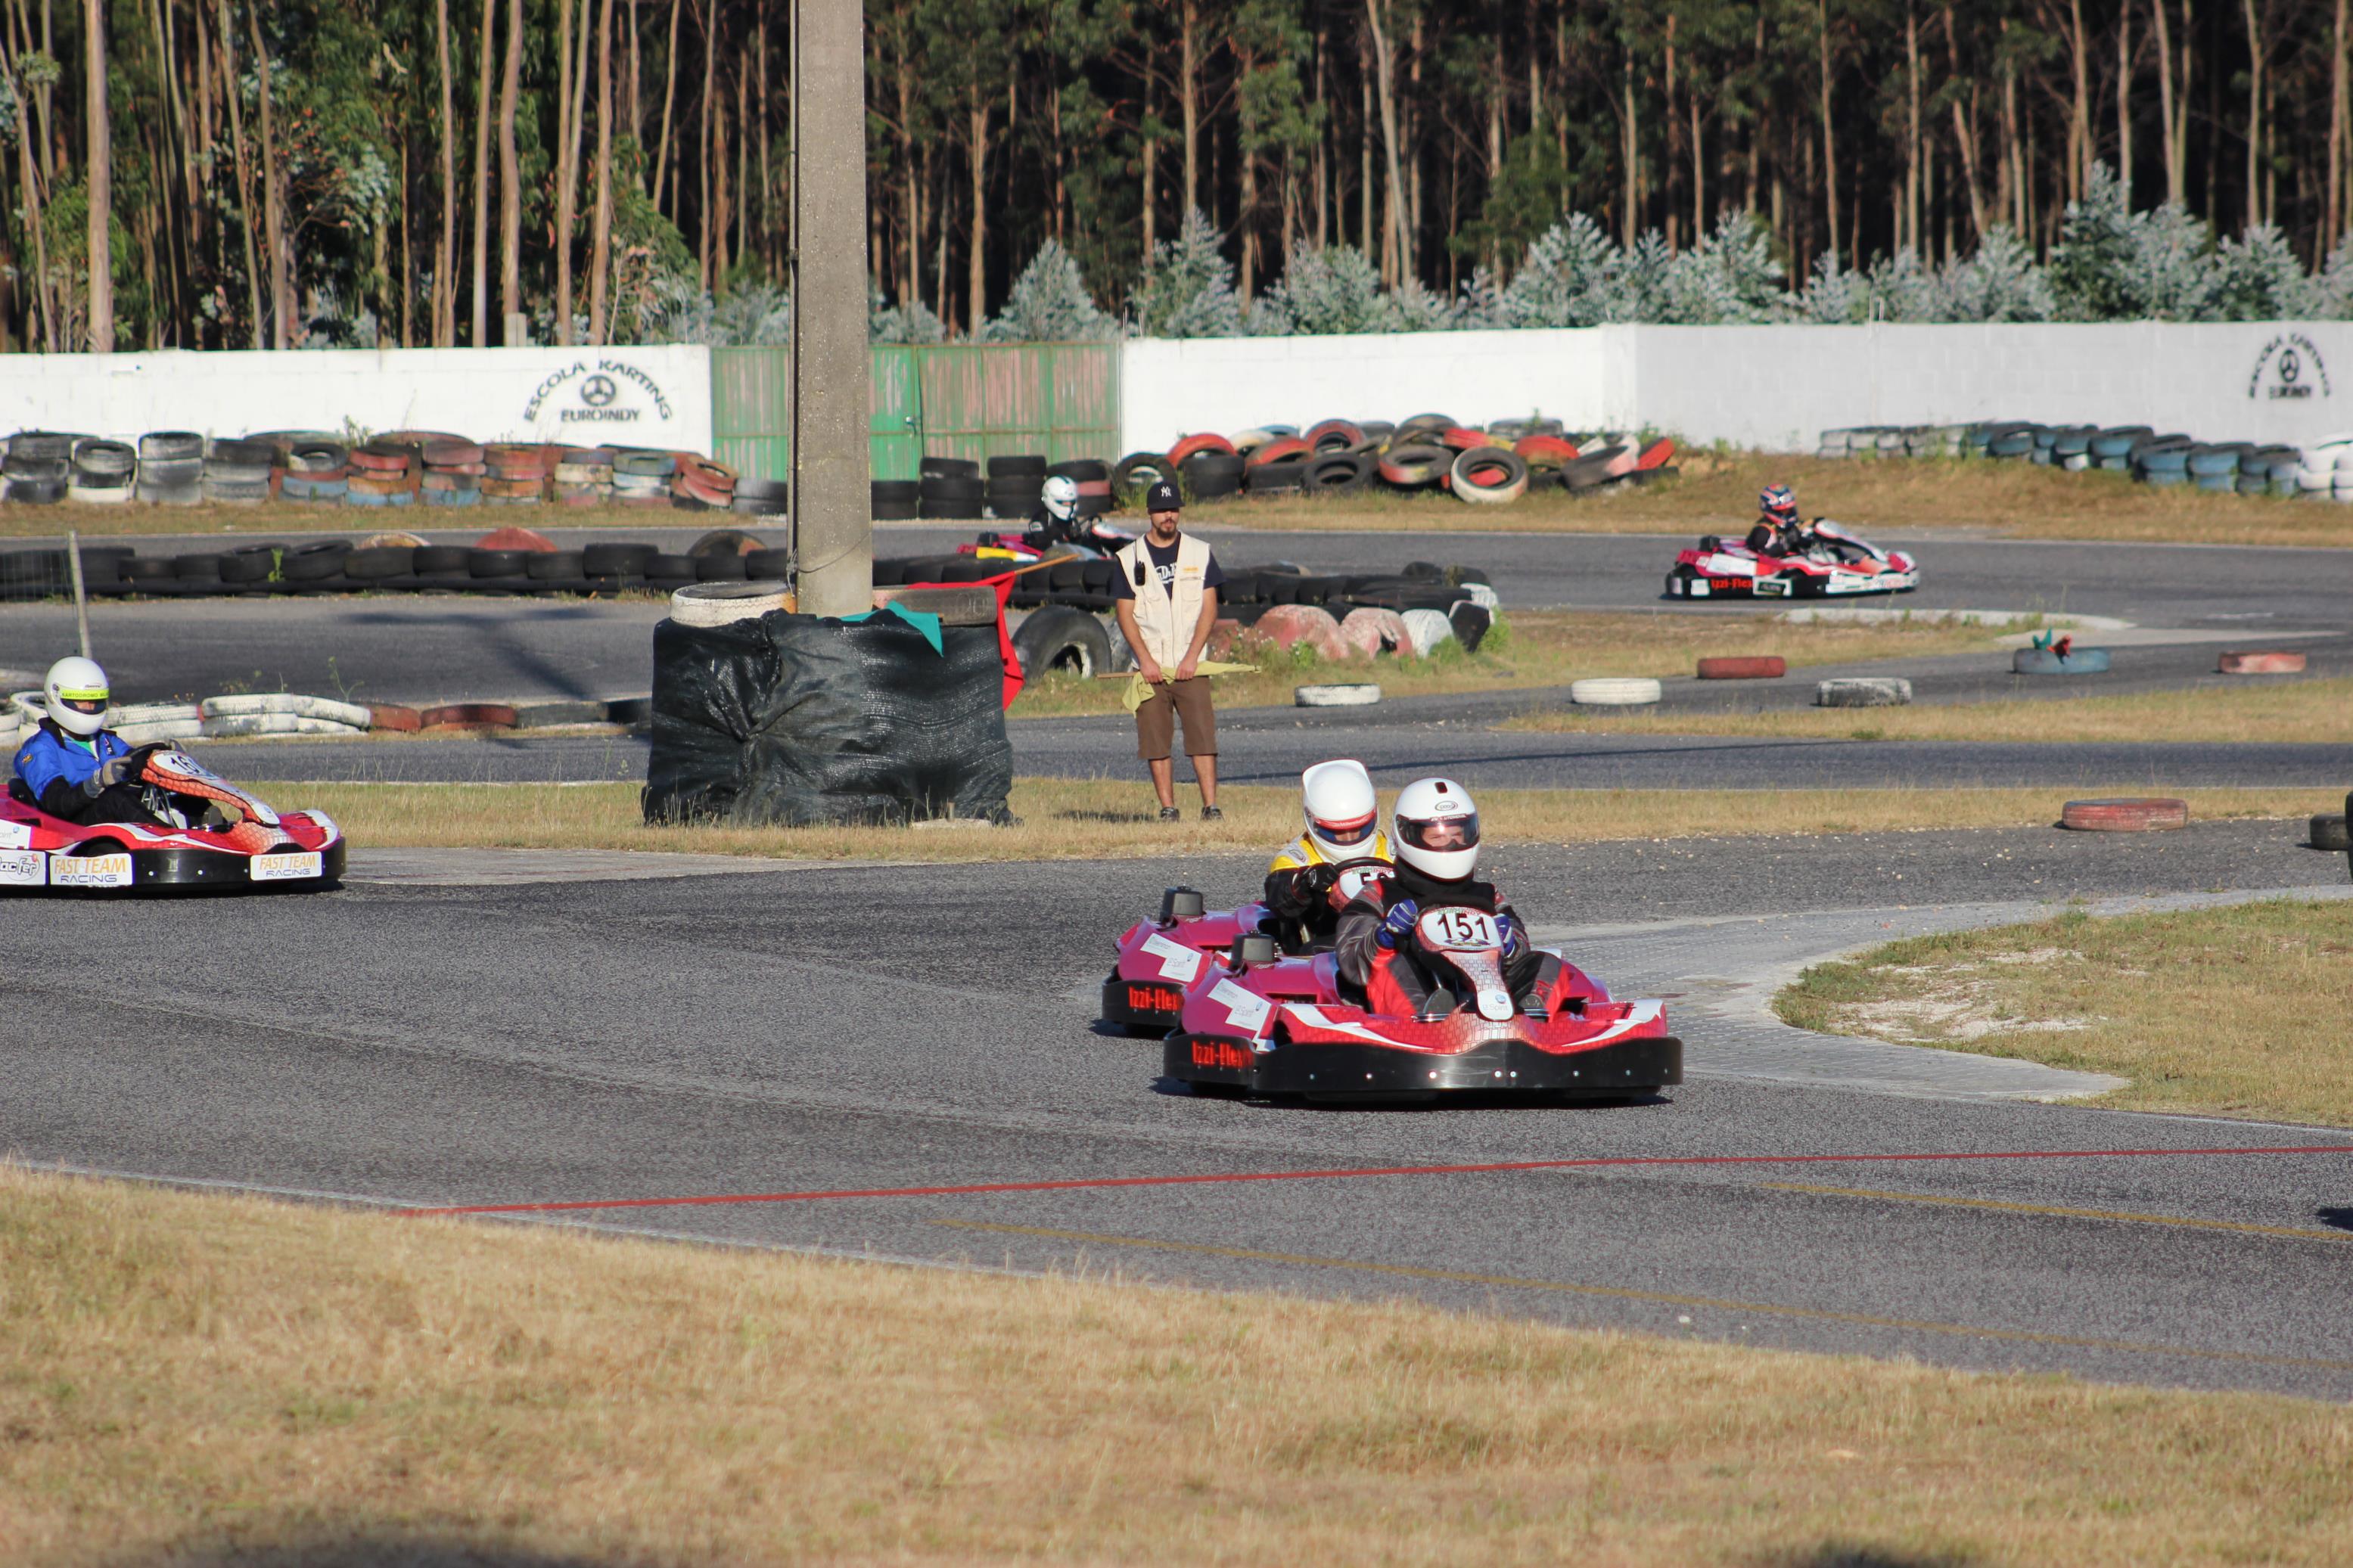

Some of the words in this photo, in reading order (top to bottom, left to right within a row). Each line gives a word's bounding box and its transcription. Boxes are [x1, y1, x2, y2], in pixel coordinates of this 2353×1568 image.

[524, 361, 587, 423] ESCOLA
[598, 359, 673, 420] KARTING
[561, 409, 640, 423] EUROINDY
[54, 859, 82, 874] FAST
[85, 858, 126, 874] TEAM
[260, 856, 285, 870] FAST
[289, 854, 315, 868] TEAM
[61, 874, 118, 883] RACING
[266, 868, 311, 877] RACING
[1438, 912, 1489, 940] 151
